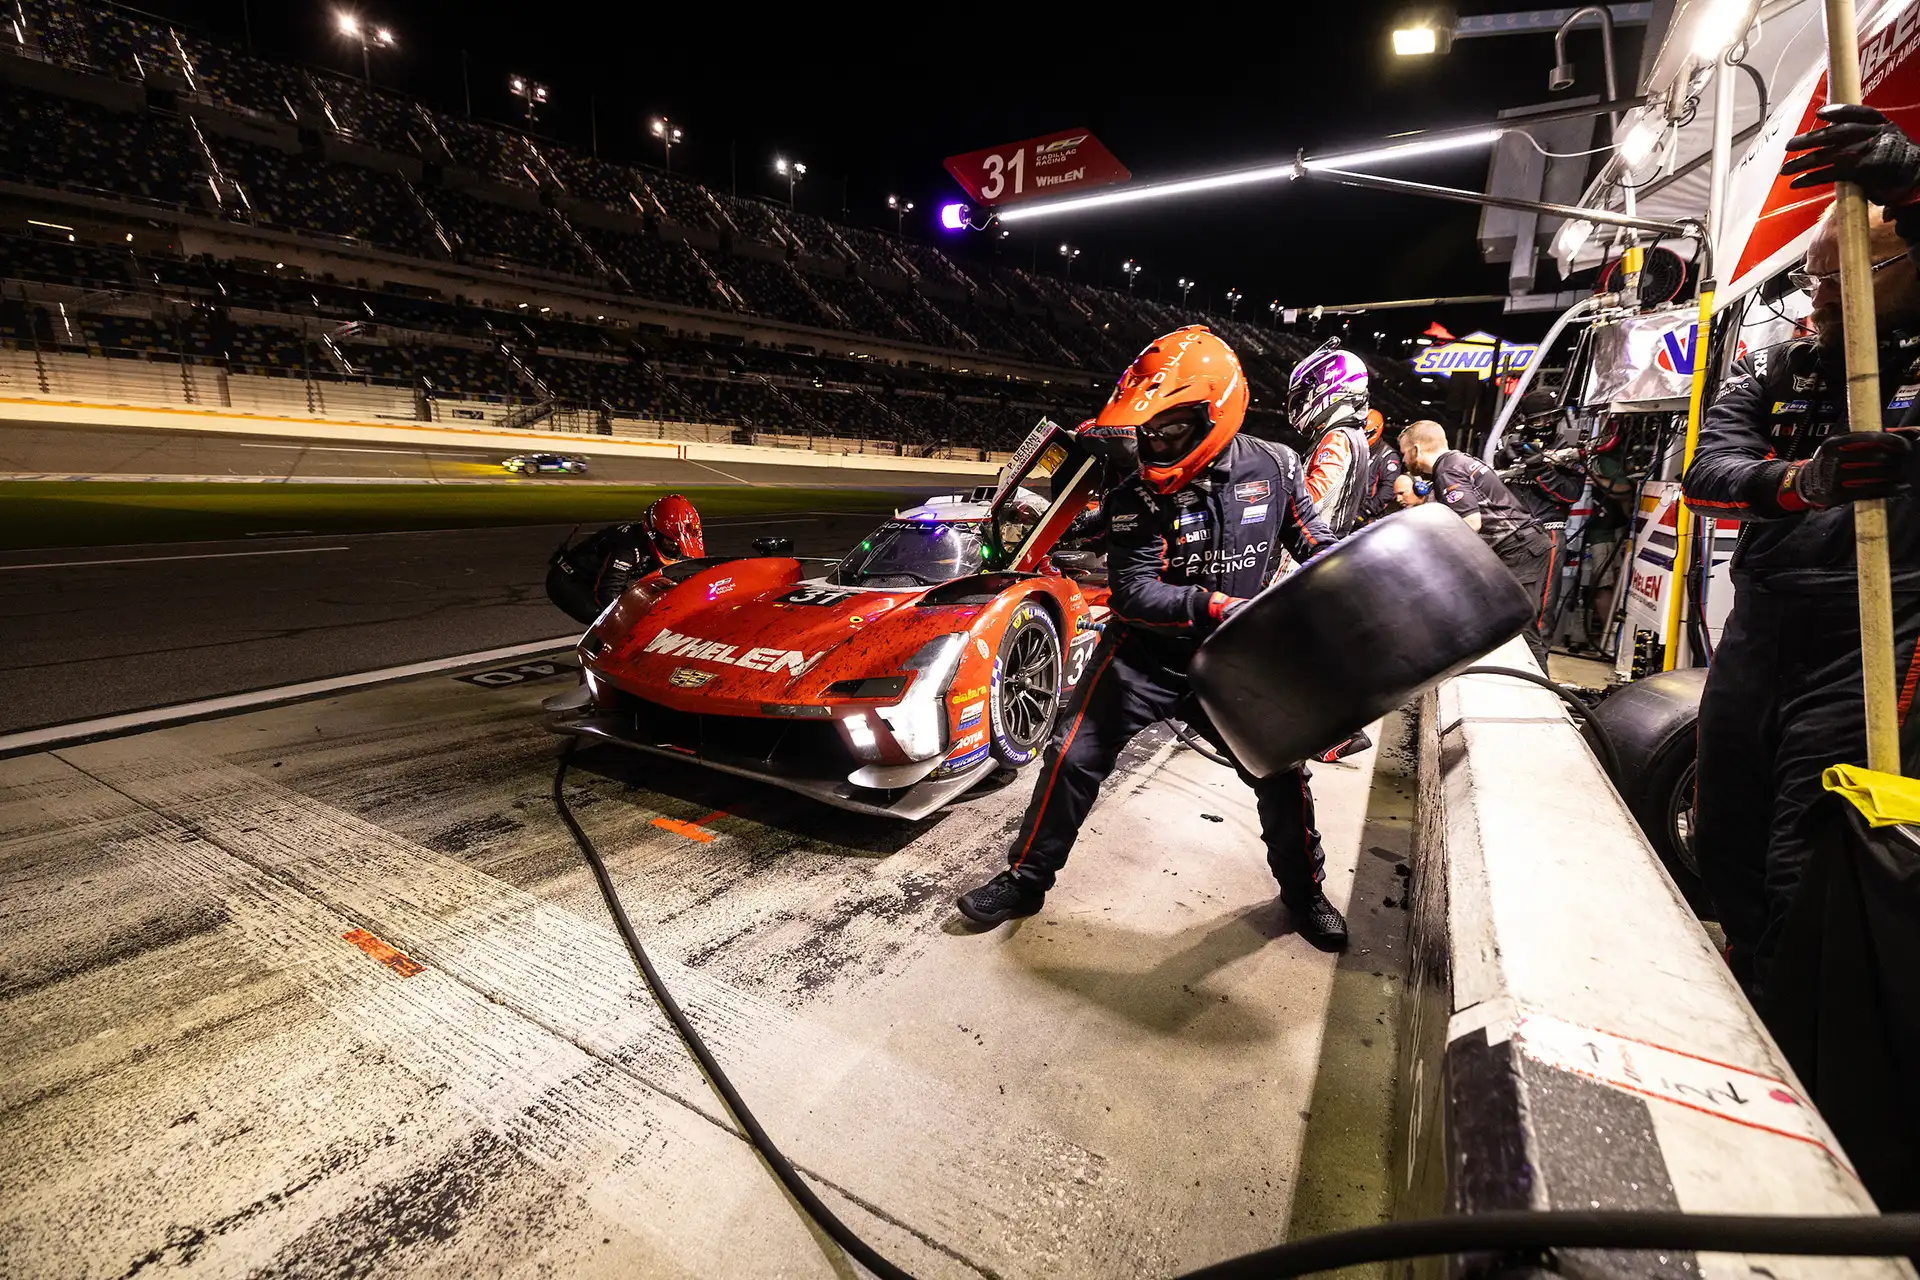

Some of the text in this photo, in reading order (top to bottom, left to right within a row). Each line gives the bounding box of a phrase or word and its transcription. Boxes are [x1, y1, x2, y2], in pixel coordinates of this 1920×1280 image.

[1035, 155, 1067, 167] RACING
[1036, 148, 1077, 161] CADILLAC
[981, 148, 1025, 199] 31
[1035, 166, 1084, 188] WHELEN
[1134, 332, 1200, 412] CADILLAC
[1012, 433, 1040, 463] DERANI
[1171, 541, 1268, 568] CADILLAC
[1186, 556, 1256, 577] RACING
[789, 588, 848, 605] 31
[643, 628, 824, 676] WHELEN
[998, 738, 1028, 762] MICHELIN
